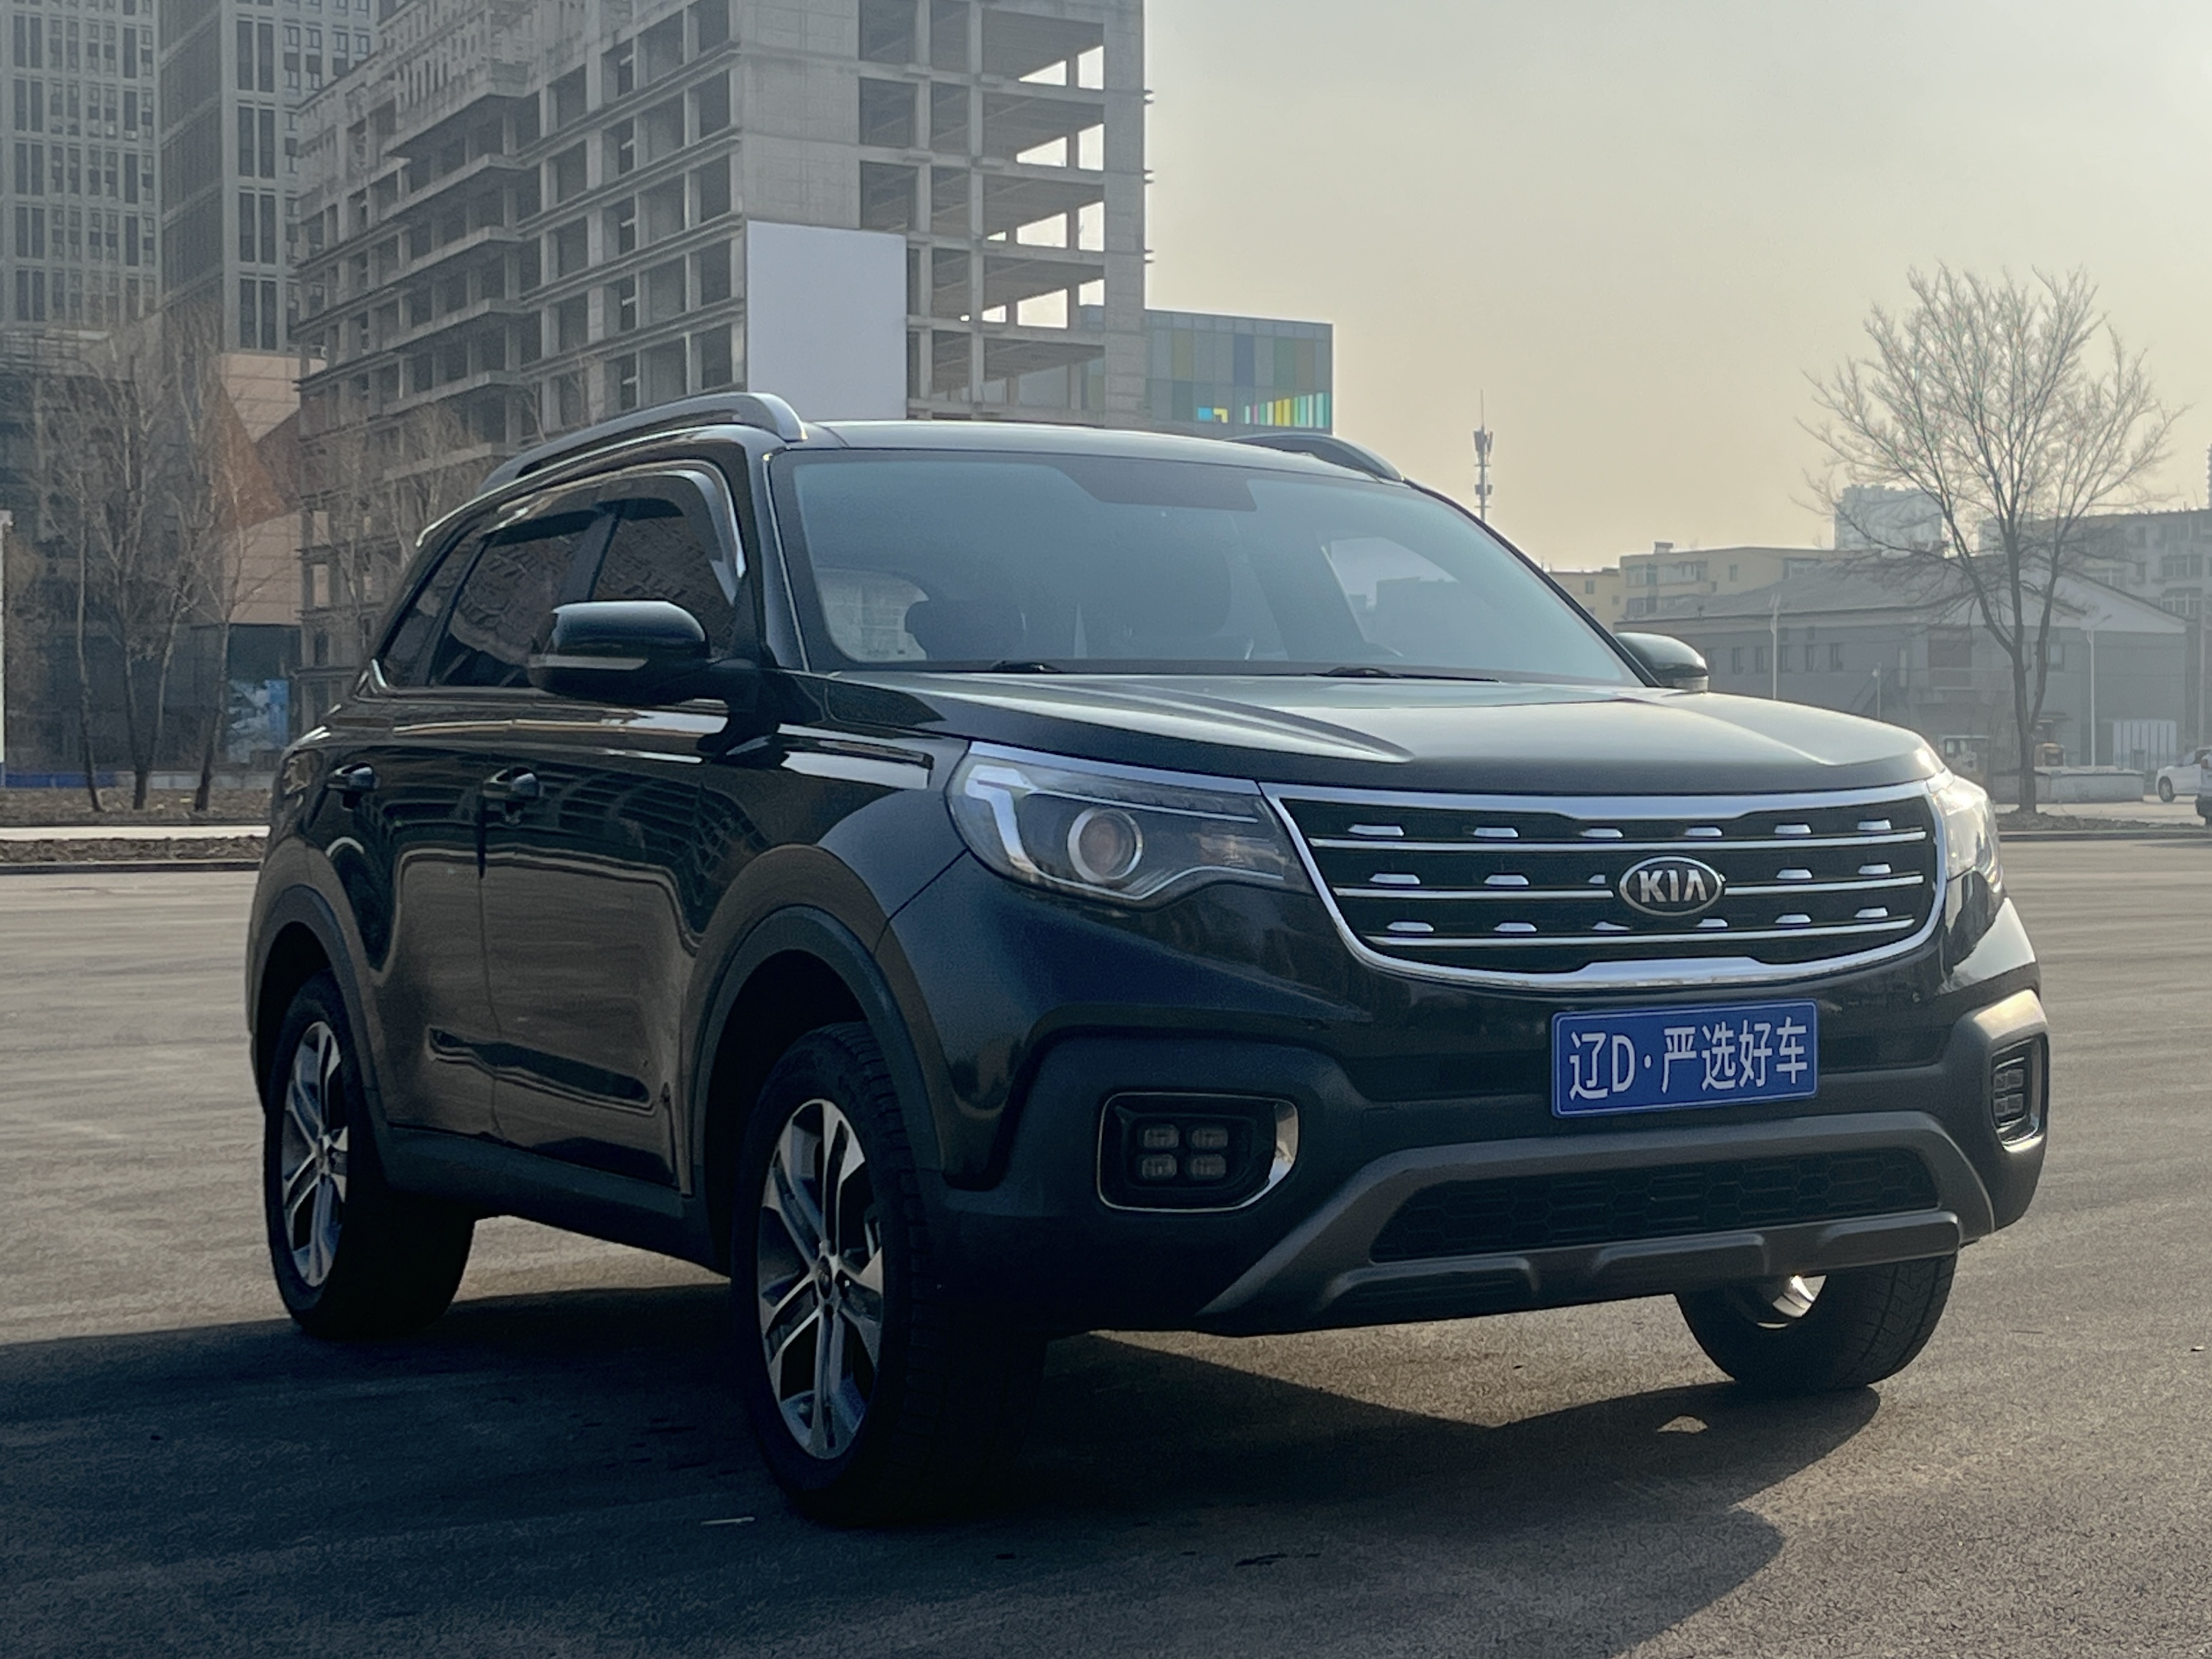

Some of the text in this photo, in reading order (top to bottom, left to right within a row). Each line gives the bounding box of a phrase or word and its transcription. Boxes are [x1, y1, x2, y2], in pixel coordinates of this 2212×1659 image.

[1637, 869, 1708, 902] KIA
[1569, 1016, 1807, 1101] 辽D·严选好车
